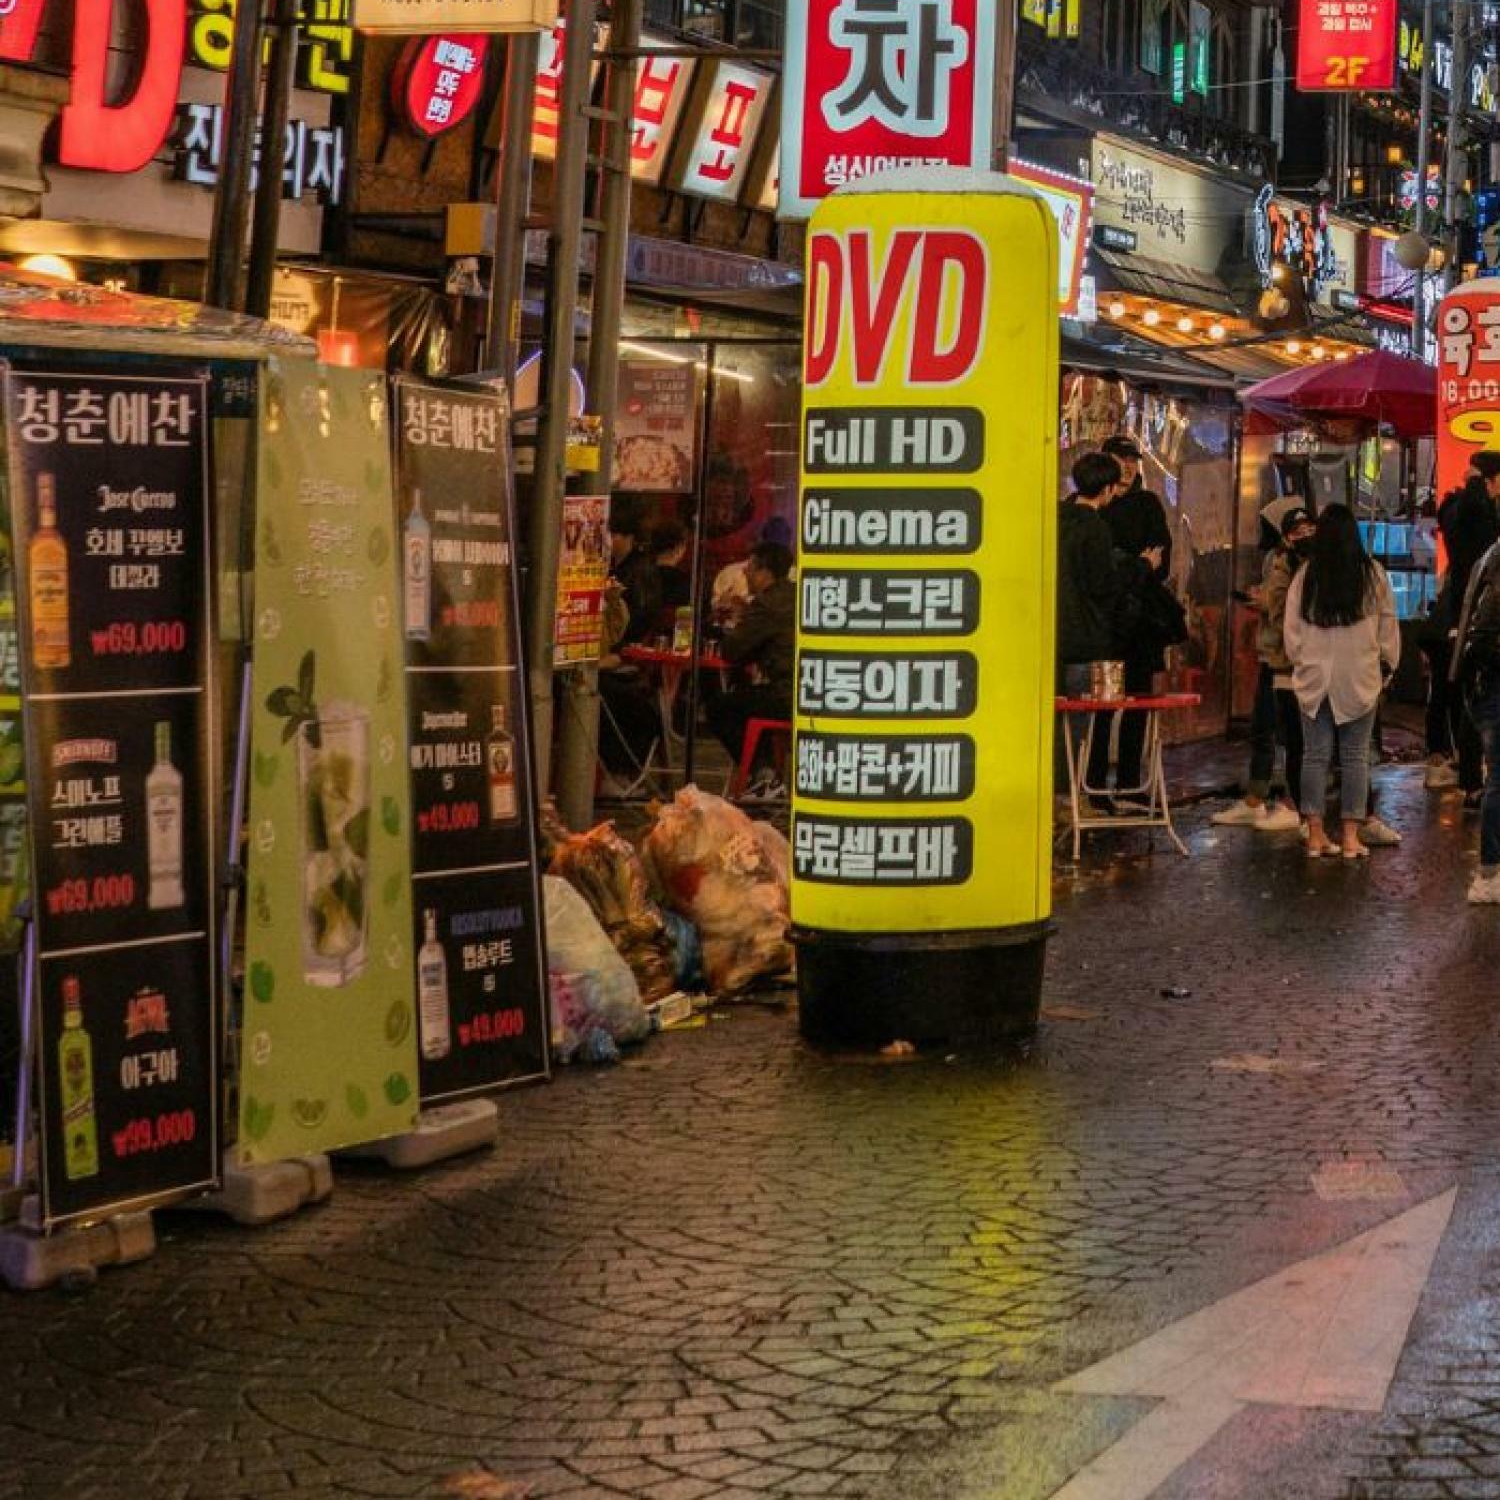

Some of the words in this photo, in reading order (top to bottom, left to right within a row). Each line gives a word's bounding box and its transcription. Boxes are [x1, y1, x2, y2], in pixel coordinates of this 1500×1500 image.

[1325, 56, 1370, 87] 2F
[804, 229, 988, 385] DVD
[17, 387, 196, 447] 청춘예찬
[404, 396, 500, 453] 청춘예찬
[806, 418, 876, 465] Full
[890, 418, 966, 464] HD
[803, 498, 969, 546] Cinema
[800, 659, 962, 712] 진동의자
[796, 821, 957, 879] 무료셀프바
